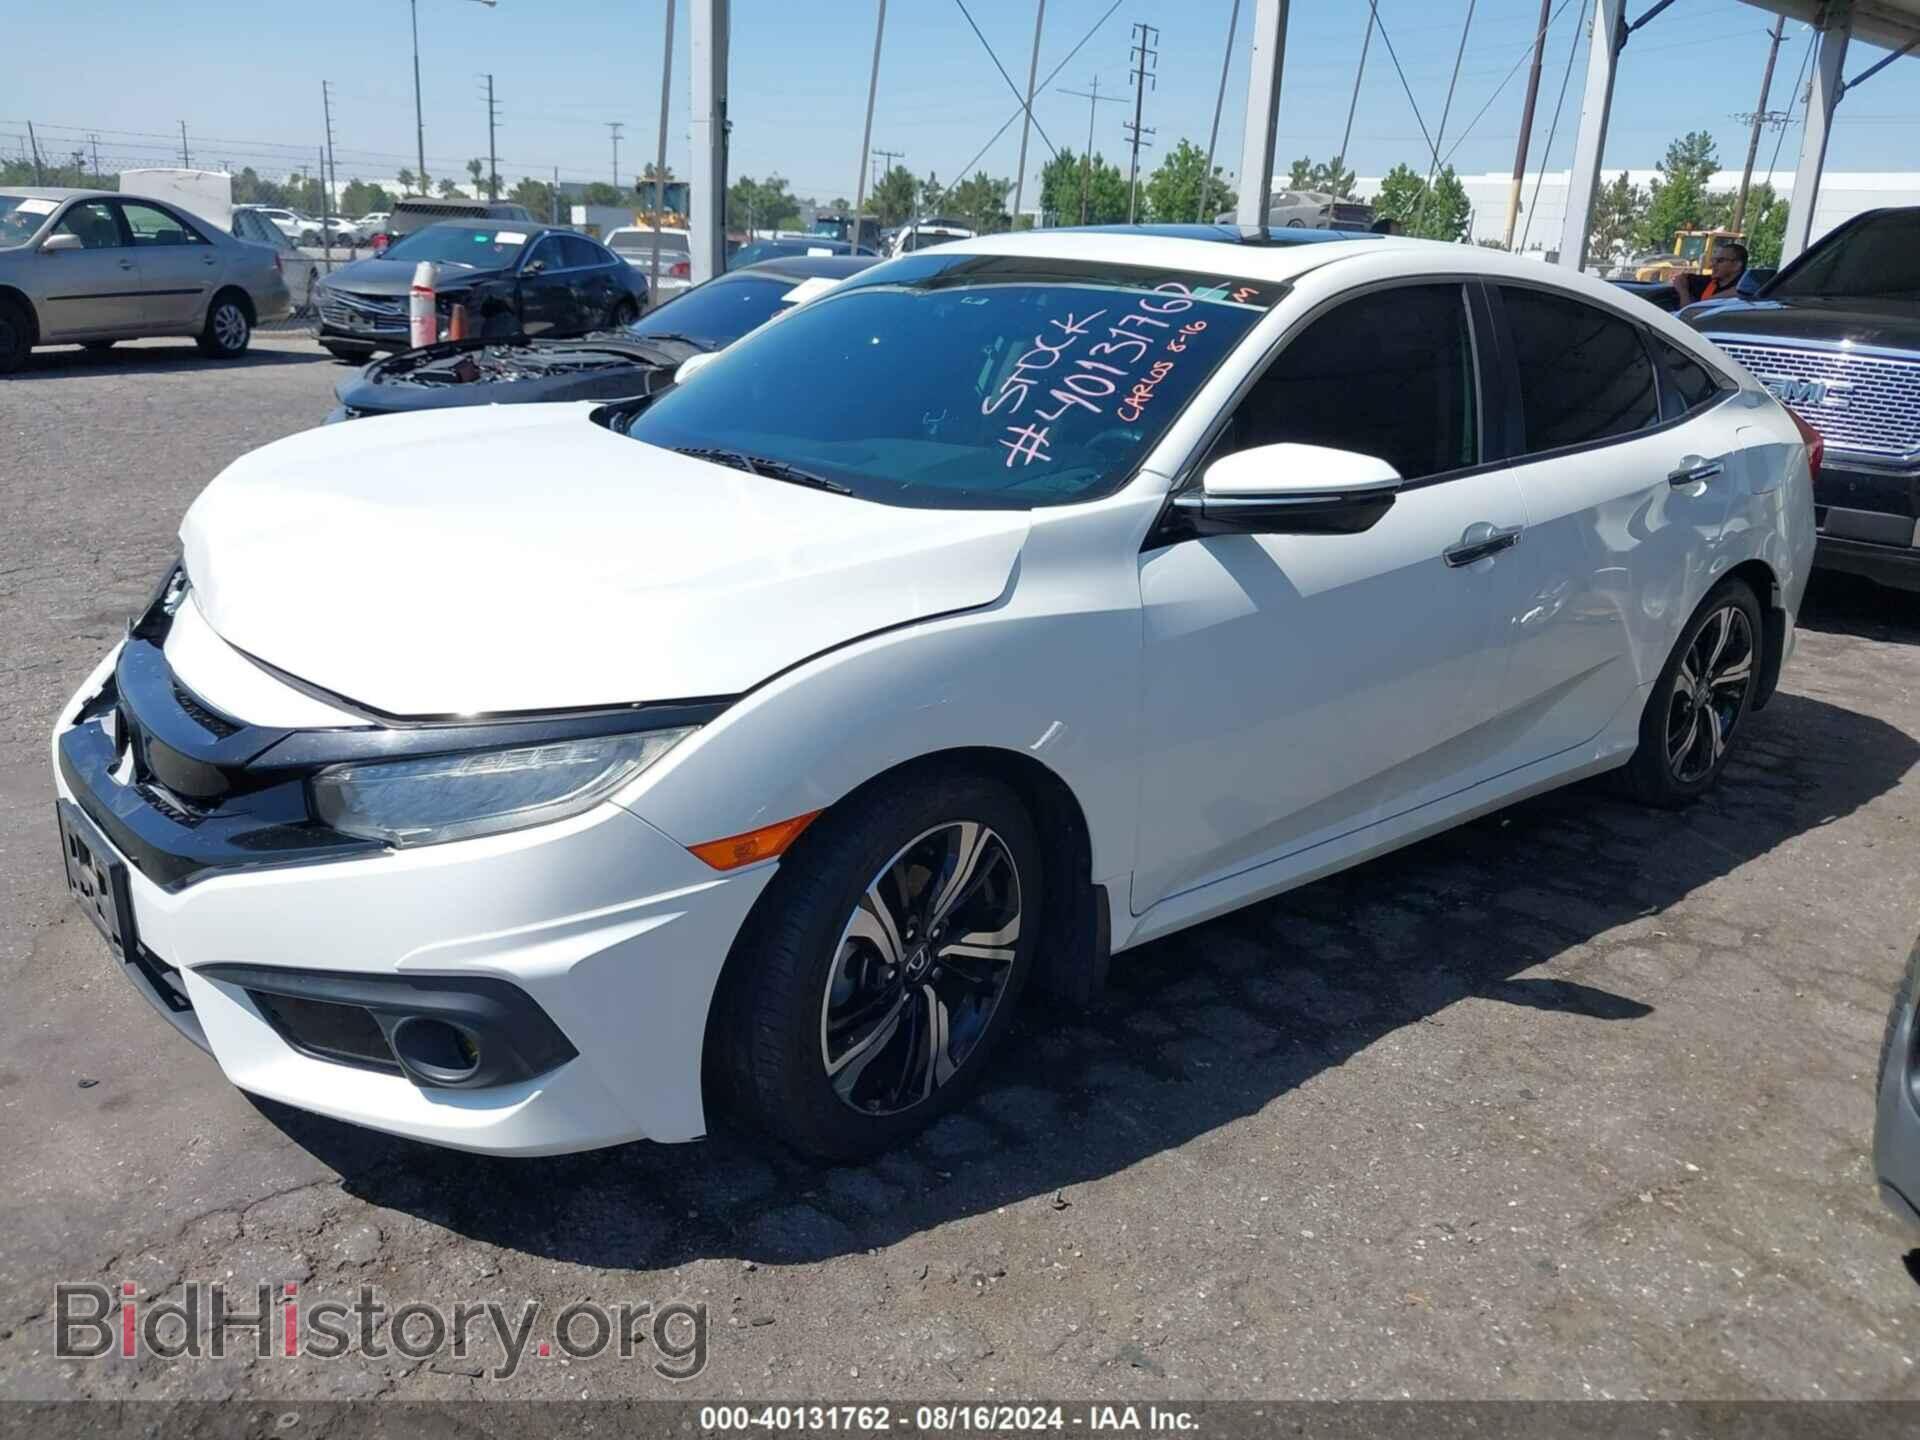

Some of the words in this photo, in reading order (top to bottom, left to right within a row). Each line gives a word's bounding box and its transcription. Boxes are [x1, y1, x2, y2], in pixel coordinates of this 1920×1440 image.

[982, 309, 1107, 415] STOCK
[1117, 361, 1174, 422] CARLOS
[1167, 320, 1207, 353] 8-16
